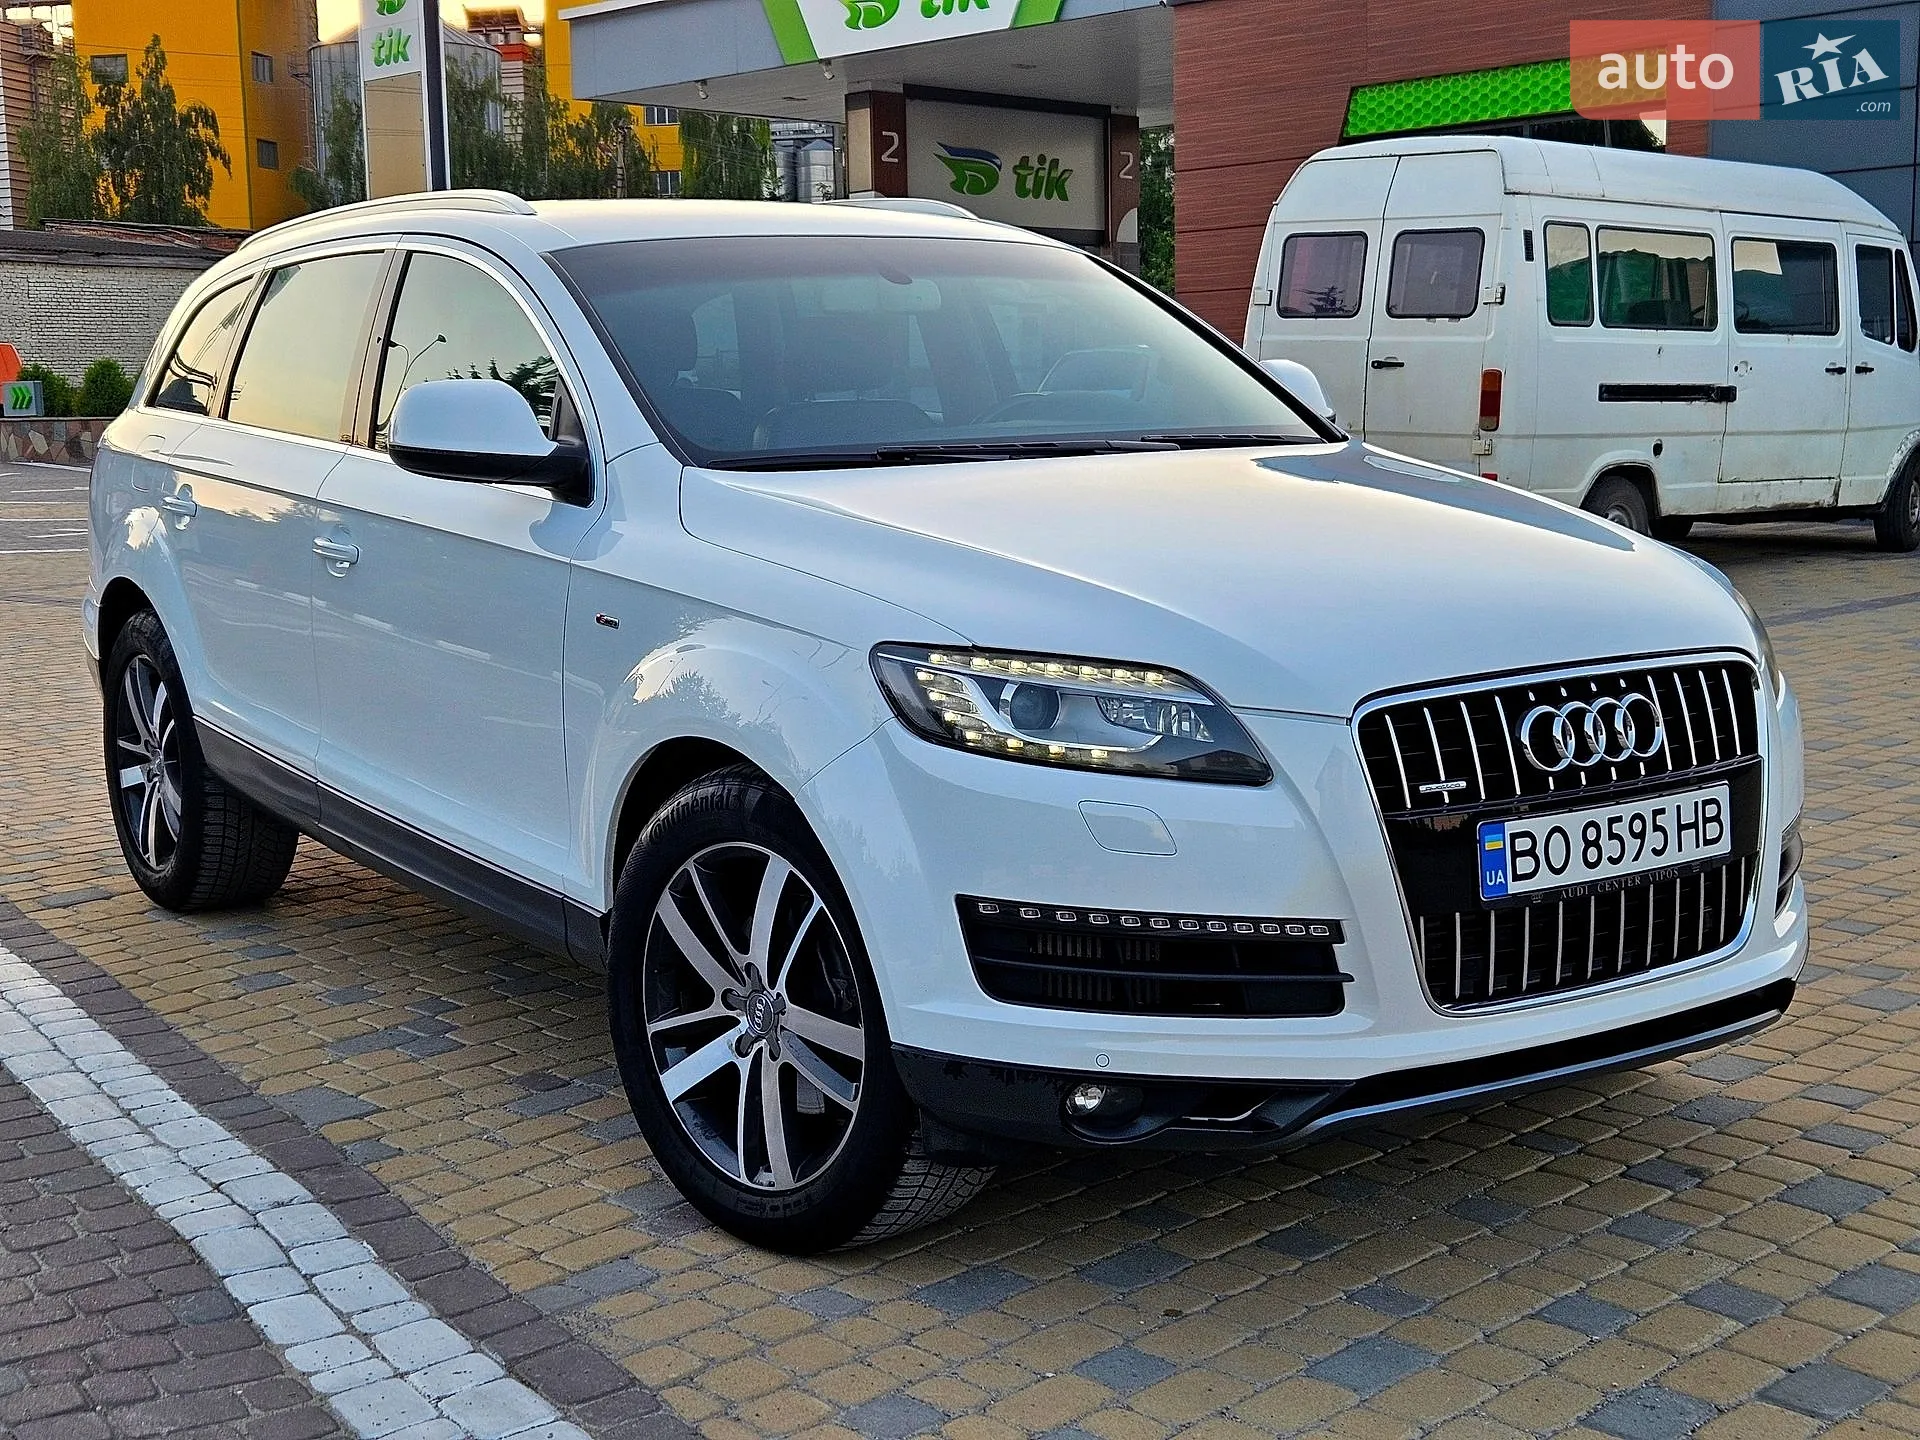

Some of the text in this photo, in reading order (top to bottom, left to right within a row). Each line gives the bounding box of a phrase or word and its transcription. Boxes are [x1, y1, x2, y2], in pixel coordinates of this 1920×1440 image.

[371, 27, 411, 67] tik
[881, 131, 899, 163] 2
[1012, 153, 1074, 201] tik
[1119, 151, 1134, 180] 2
[1508, 797, 1725, 883] BO 8595 HB
[1486, 869, 1506, 886] UA
[1560, 885, 1589, 899] AUDI
[1597, 876, 1642, 893] CENTER
